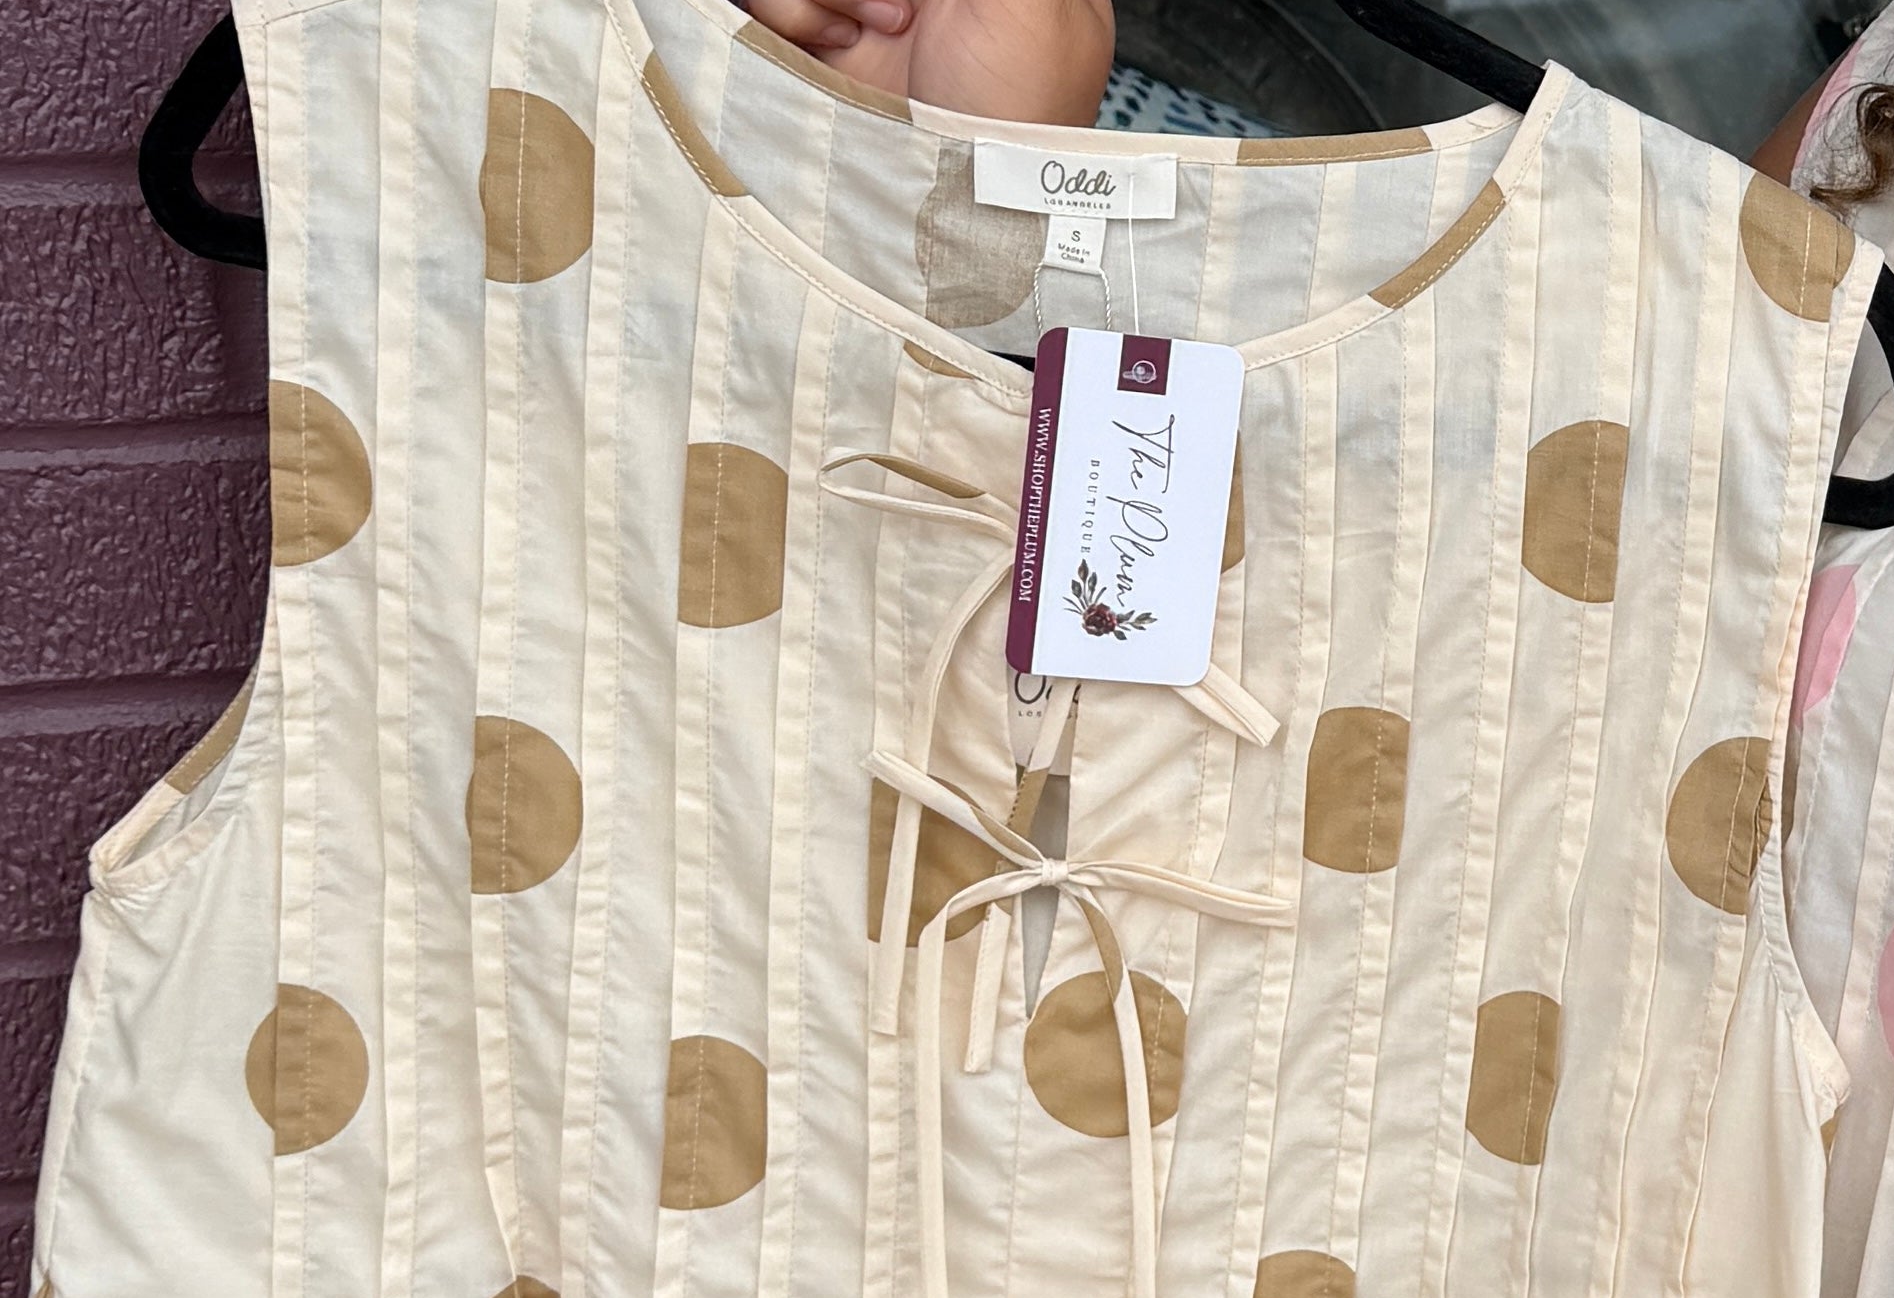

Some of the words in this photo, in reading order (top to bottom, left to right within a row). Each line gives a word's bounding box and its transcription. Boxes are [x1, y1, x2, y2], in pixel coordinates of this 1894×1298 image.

[1041, 160, 1116, 196] Oddi
[1071, 230, 1081, 242] S
[1112, 414, 1174, 493] The
[1018, 408, 1052, 602] WWW.SHOPTHEPLUM.COM
[1080, 459, 1100, 554] BOUTIQUE
[1106, 495, 1168, 607] Plum
